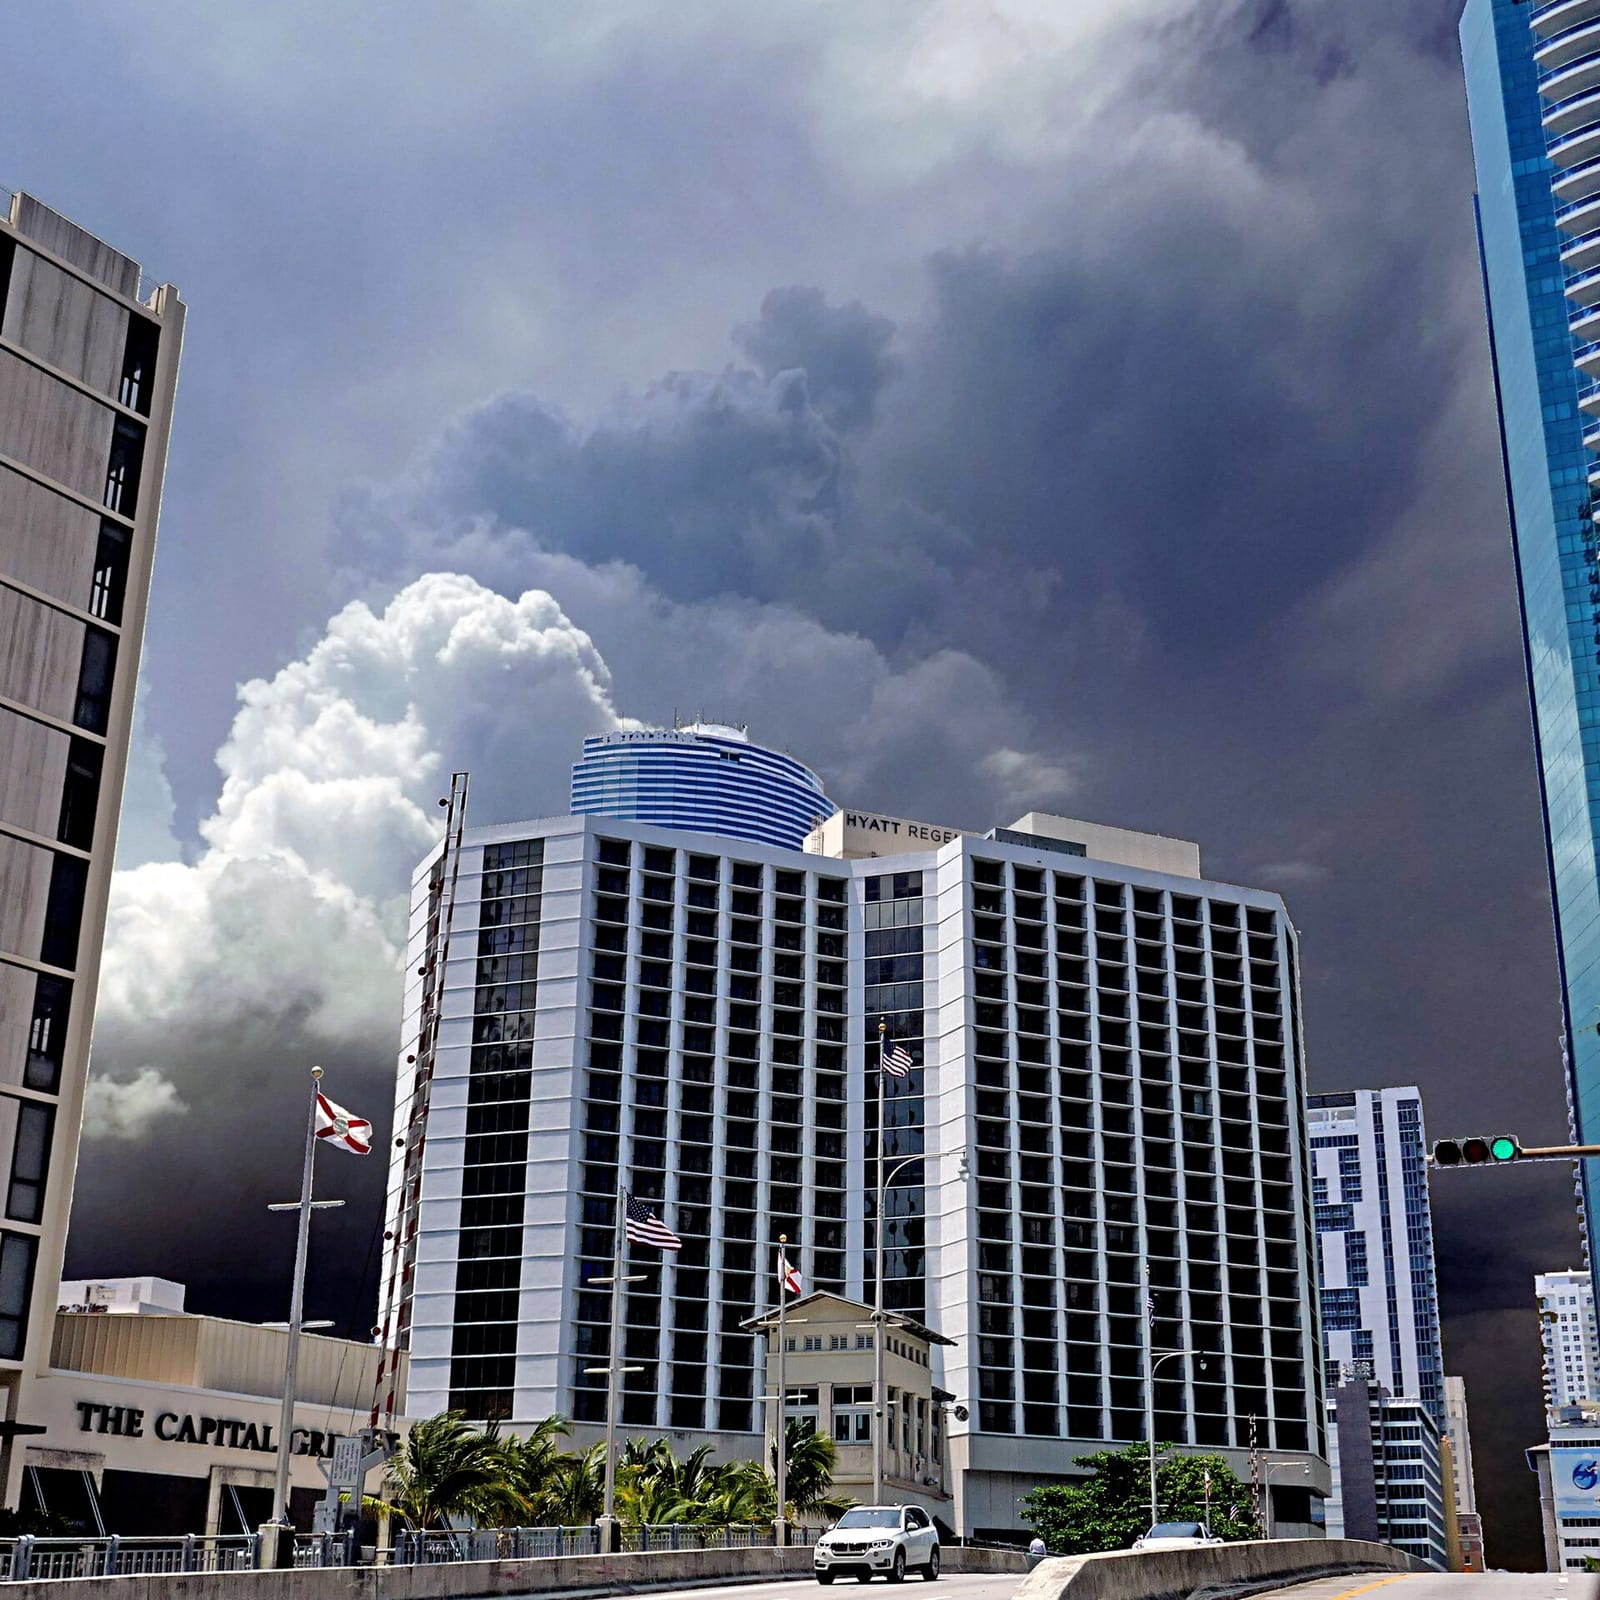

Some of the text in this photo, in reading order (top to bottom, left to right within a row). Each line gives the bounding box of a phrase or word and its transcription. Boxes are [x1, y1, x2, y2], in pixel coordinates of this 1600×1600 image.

[846, 813, 959, 844] HYATT REGE
[77, 1402, 346, 1458] THE CAPITAL GRI
